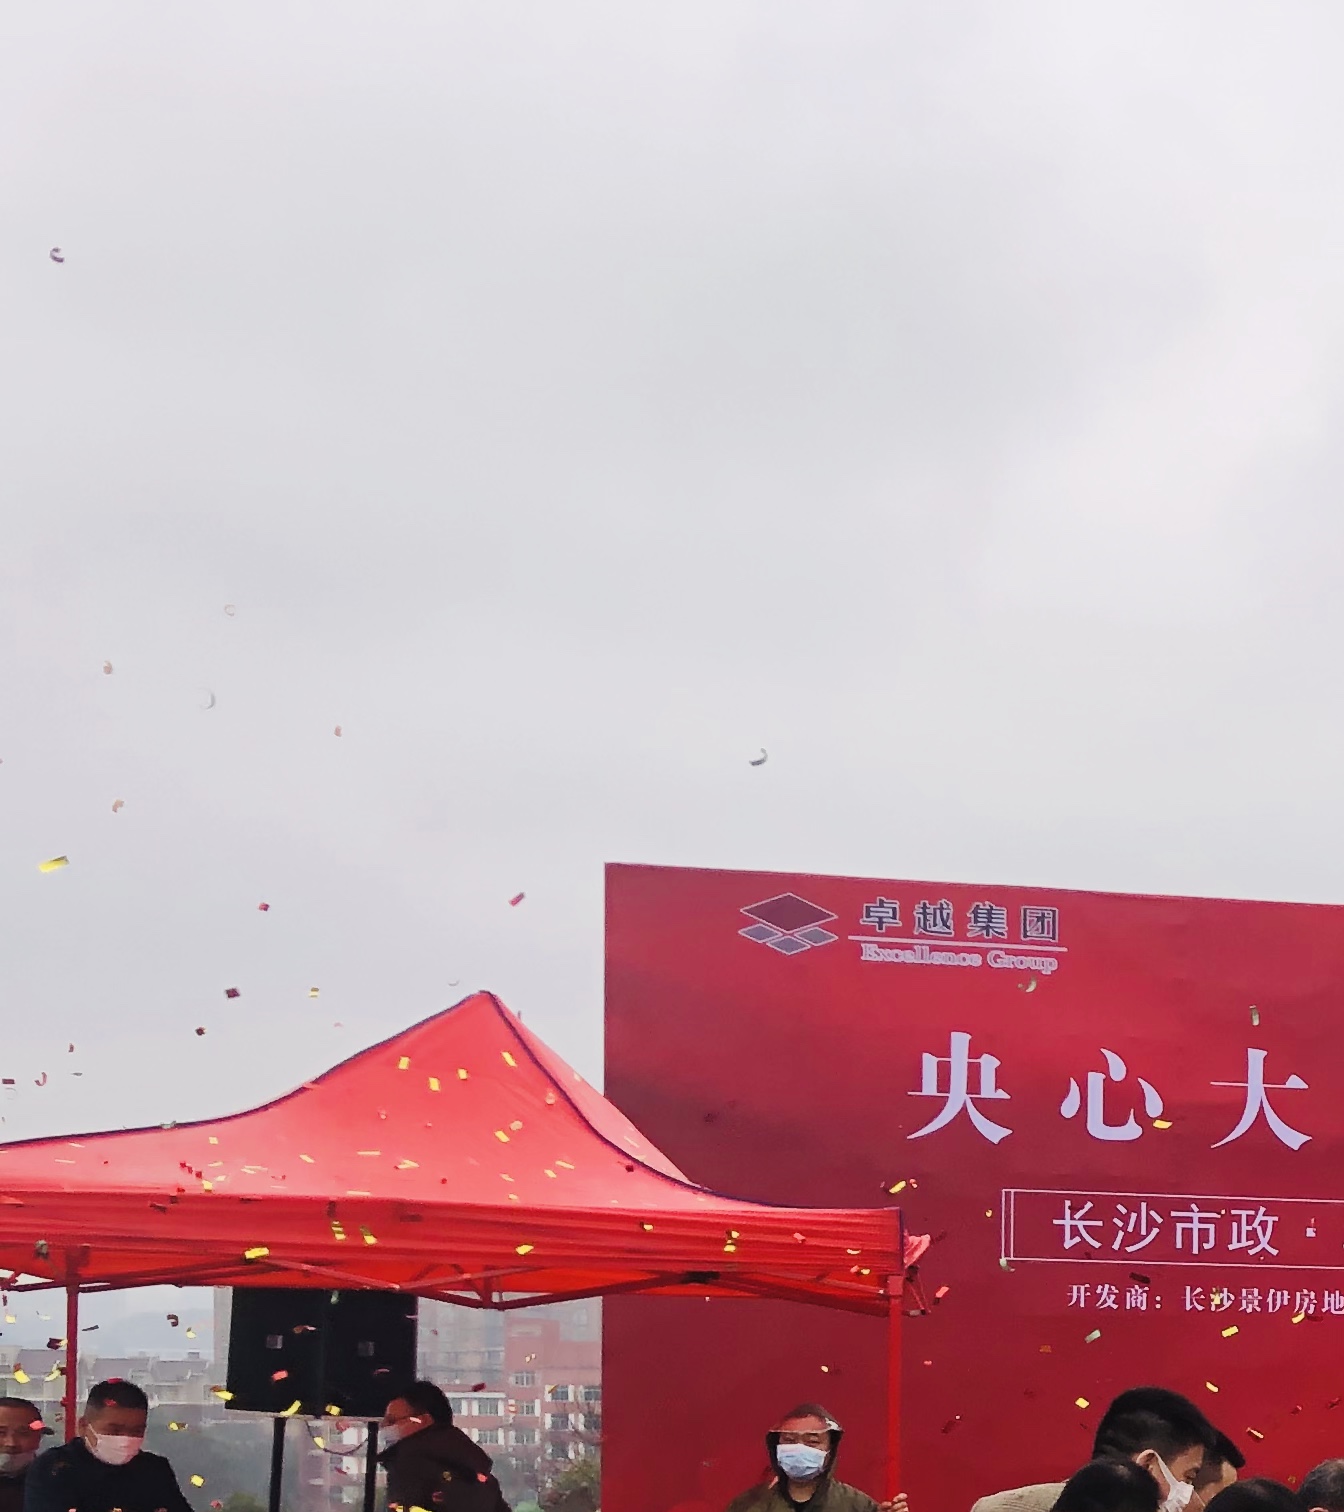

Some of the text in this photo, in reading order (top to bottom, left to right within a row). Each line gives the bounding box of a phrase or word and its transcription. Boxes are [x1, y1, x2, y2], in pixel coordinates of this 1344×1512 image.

[860, 897, 1059, 942] 卓越集团
[861, 944, 1058, 974] Excellence Group
